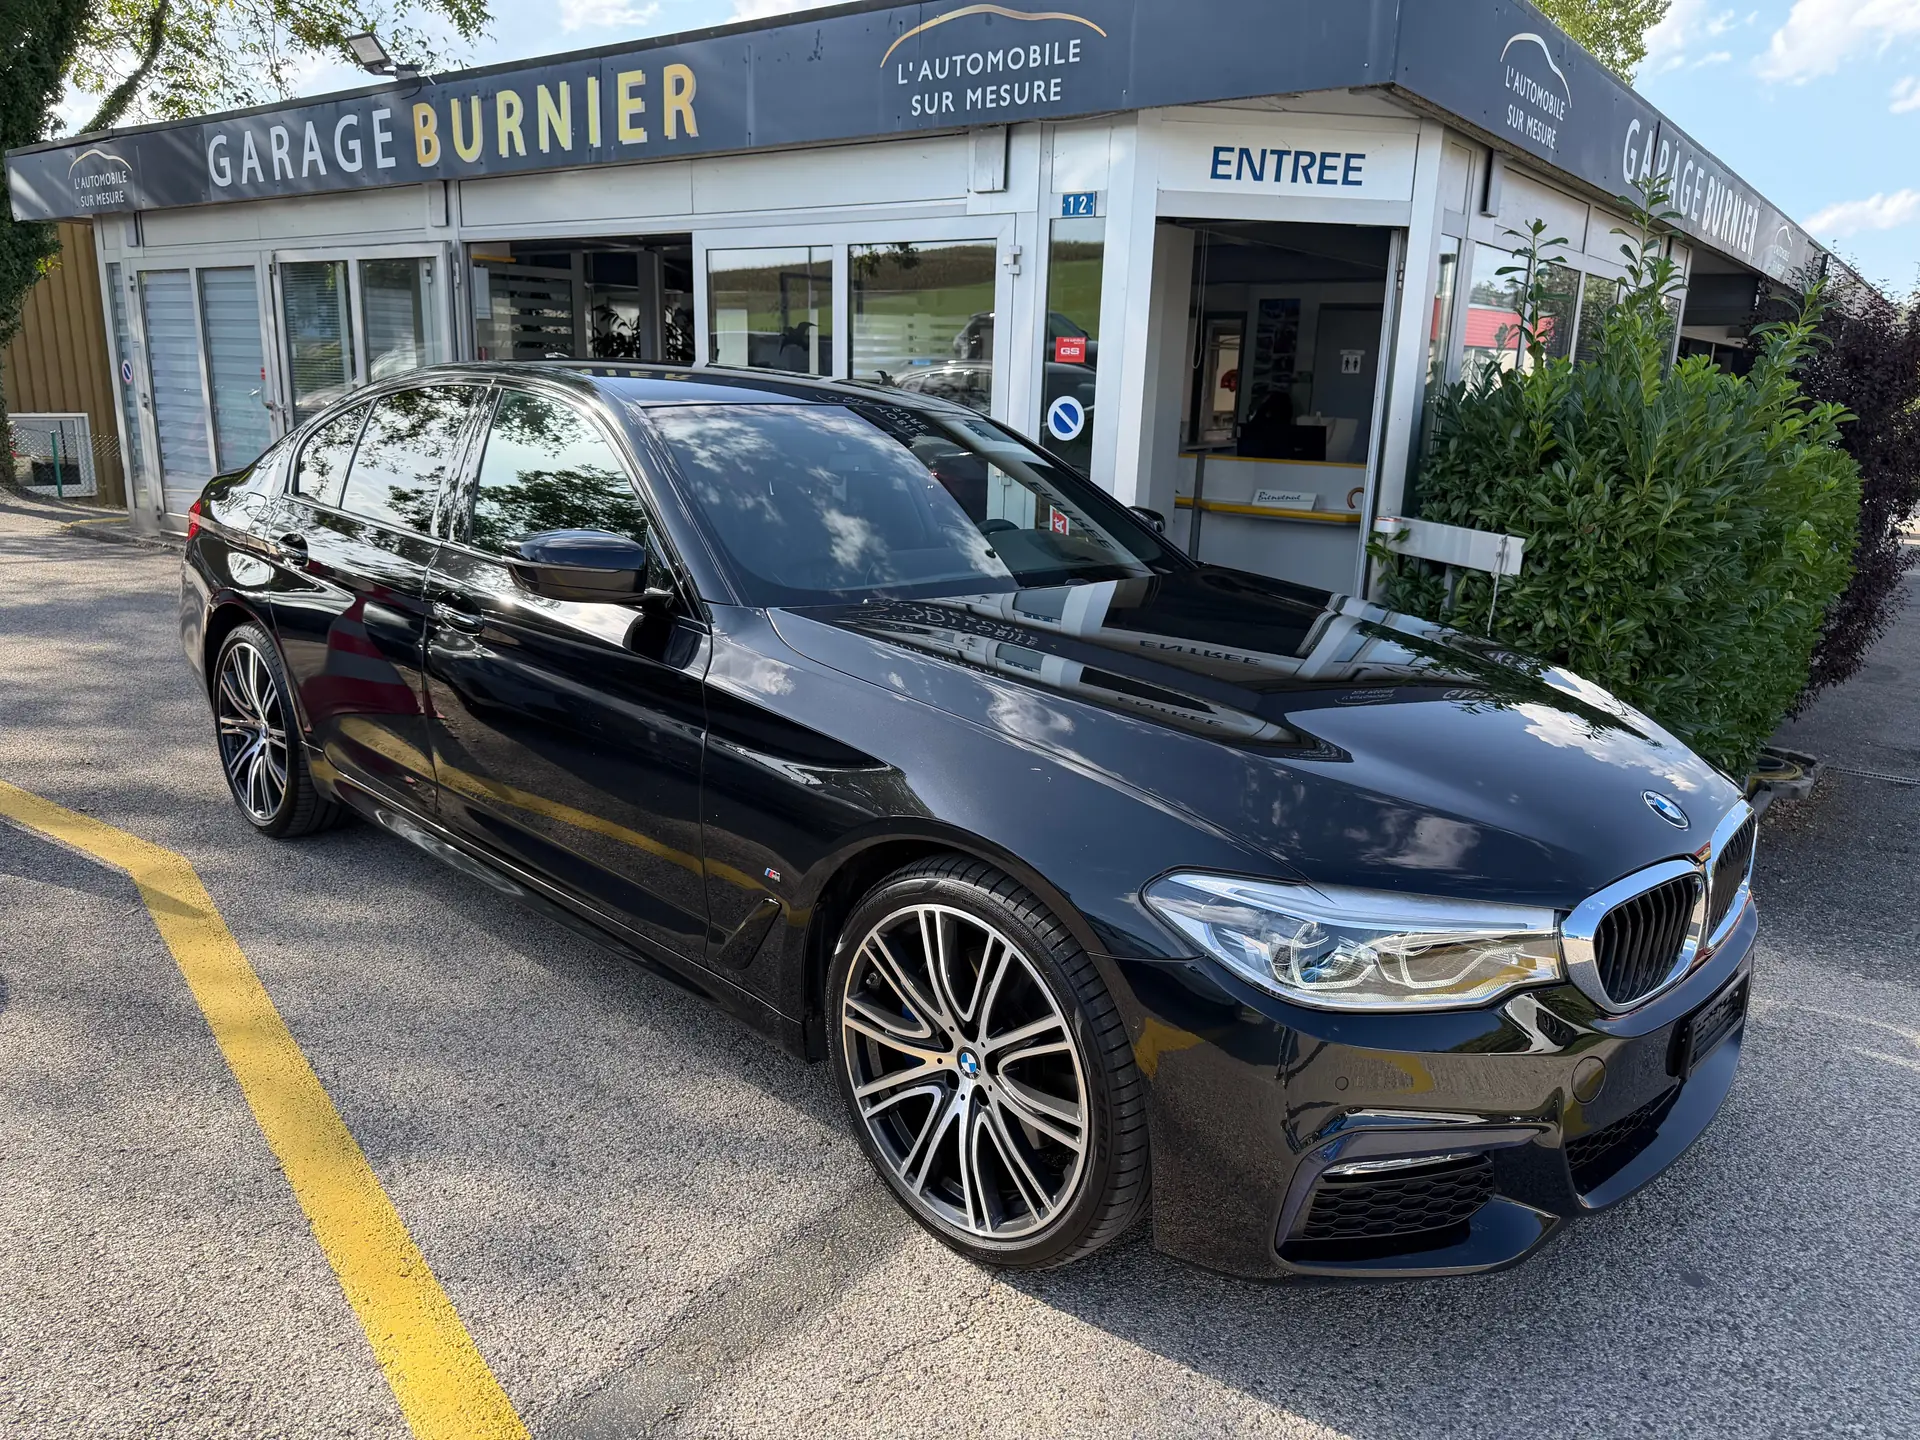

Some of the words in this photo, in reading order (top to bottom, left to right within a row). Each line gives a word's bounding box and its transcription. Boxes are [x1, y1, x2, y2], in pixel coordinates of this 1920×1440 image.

[897, 39, 1081, 85] L'AUTOMOBILE
[911, 91, 955, 117] SUR
[966, 78, 1062, 111] MESURE
[1505, 65, 1566, 121] L'AUTOMOBILE
[207, 108, 397, 187] GARAGE
[412, 63, 699, 168] BURNIER
[1506, 104, 1524, 133] SUR
[1525, 115, 1557, 150] MESURE
[74, 170, 128, 190] L'AUTOMOBILE
[1209, 146, 1366, 187] ENTREE
[80, 195, 95, 208] SUR
[96, 190, 125, 206] MESURE
[1067, 194, 1088, 215] 12
[1622, 118, 1705, 222] GARAGE
[1702, 175, 1760, 257] BURNIER
[1060, 347, 1080, 355] GS
